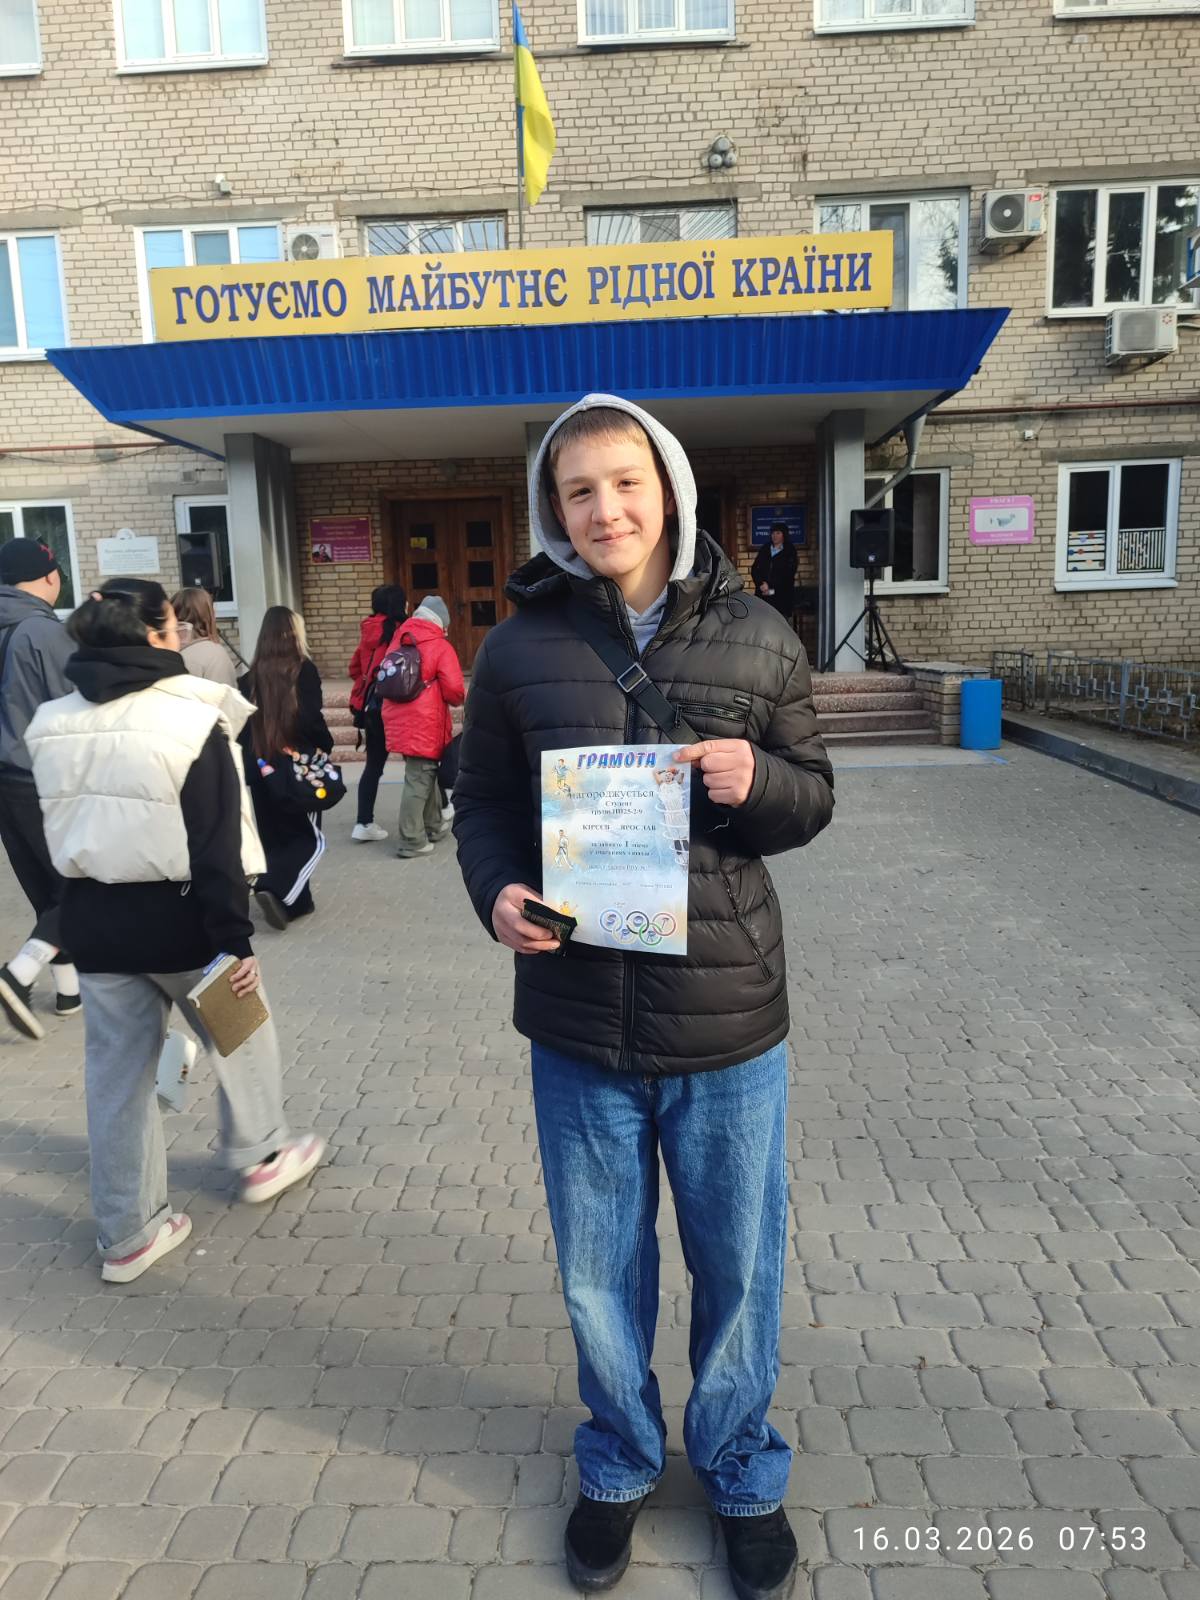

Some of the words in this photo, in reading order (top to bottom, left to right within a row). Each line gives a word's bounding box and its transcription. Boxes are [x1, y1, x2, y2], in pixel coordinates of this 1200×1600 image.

[172, 277, 348, 325] ГОТУЄМО
[366, 261, 569, 315] МАЙБУТНЄ
[587, 249, 717, 310] РІДНОЇ
[731, 244, 874, 299] КРАЇНИ
[577, 751, 657, 769] ГРАМОТА
